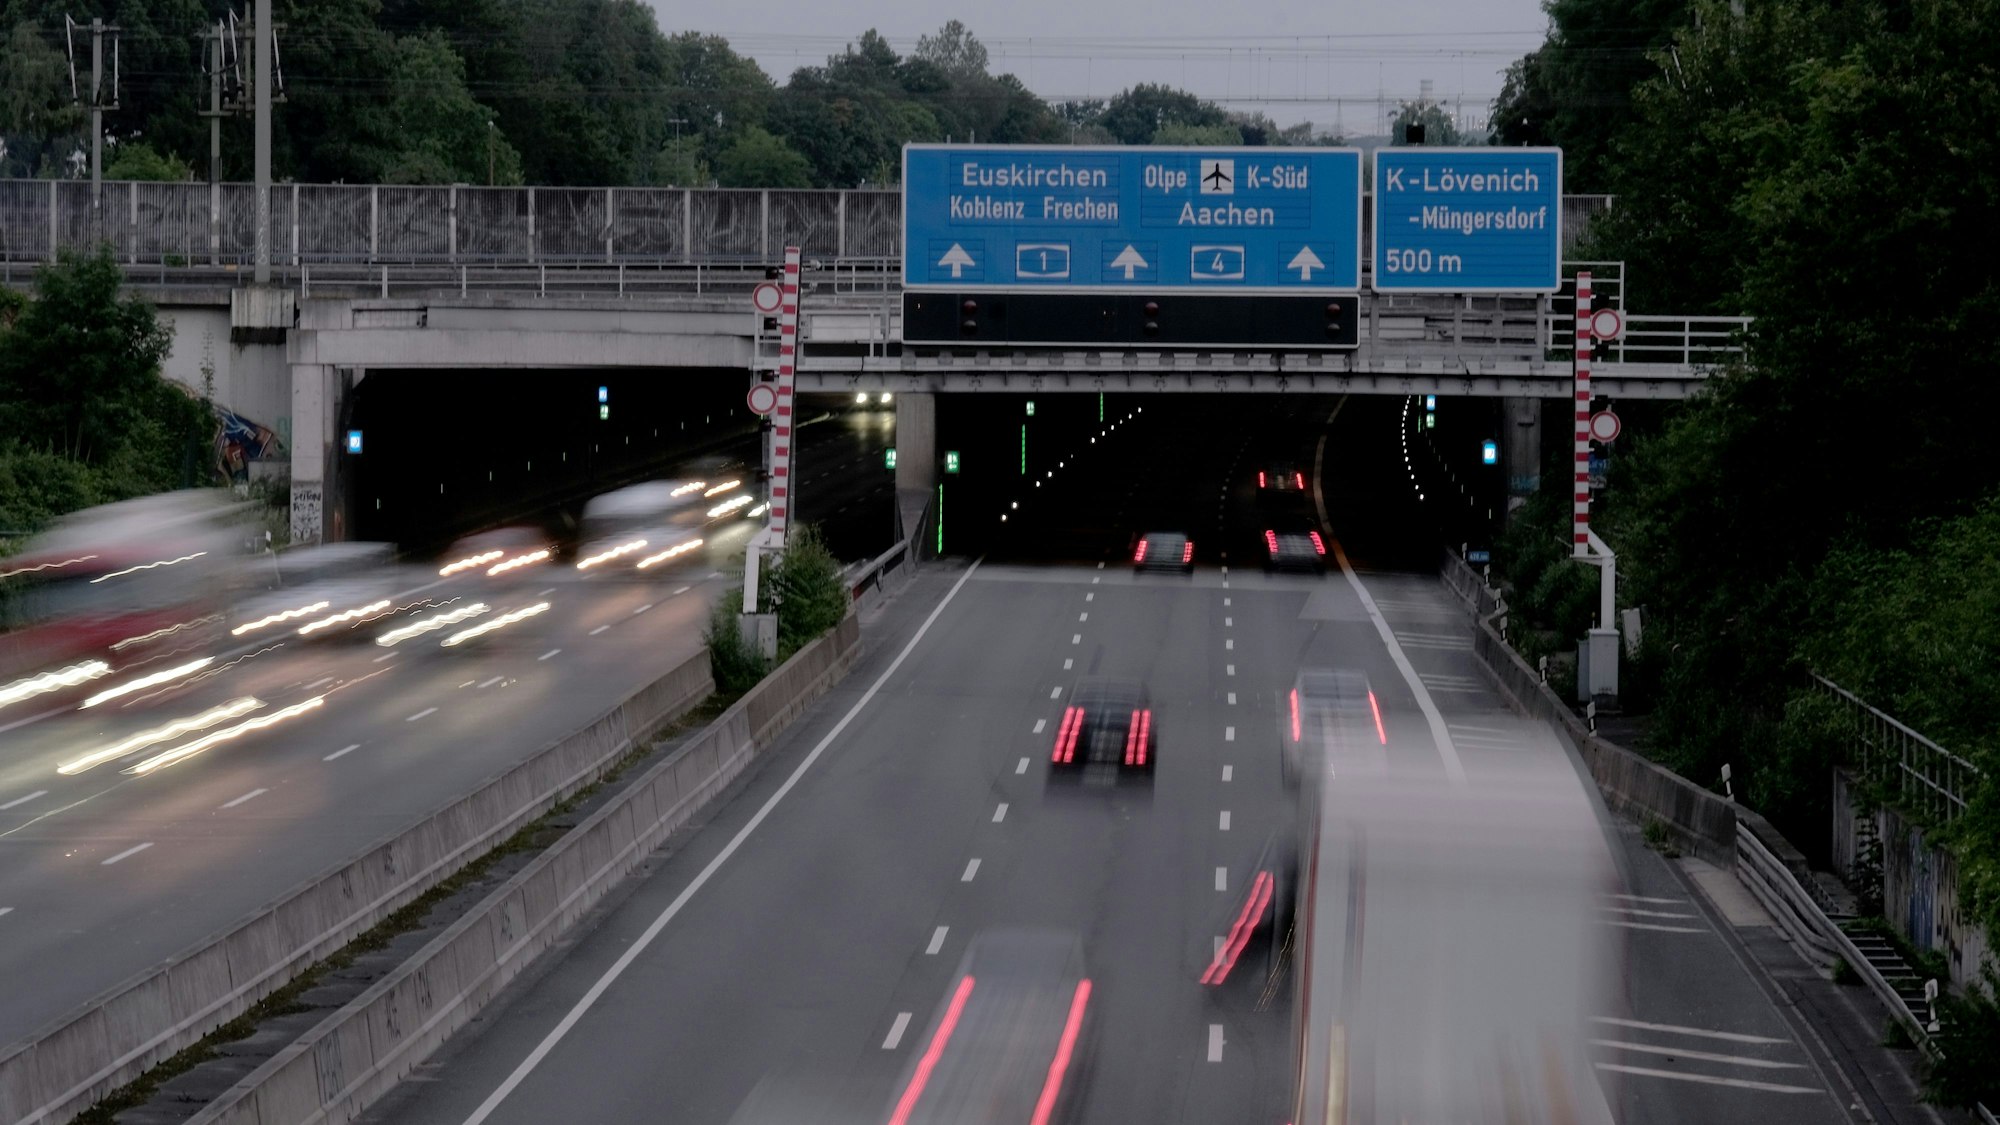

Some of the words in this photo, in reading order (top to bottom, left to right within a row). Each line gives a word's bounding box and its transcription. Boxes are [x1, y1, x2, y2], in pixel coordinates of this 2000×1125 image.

[963, 163, 1107, 187] Euskirchen
[1145, 164, 1187, 194] Olpe
[1247, 164, 1308, 189] K-Süd
[950, 195, 1025, 219] Koblenz
[1043, 196, 1119, 220] Frechen
[1178, 201, 1275, 226] Aachen
[1409, 205, 1547, 235] -Müngersdorf
[1039, 251, 1047, 271] 1
[1211, 252, 1225, 273] 4
[1386, 249, 1432, 273] 500
[1438, 254, 1462, 273] m
